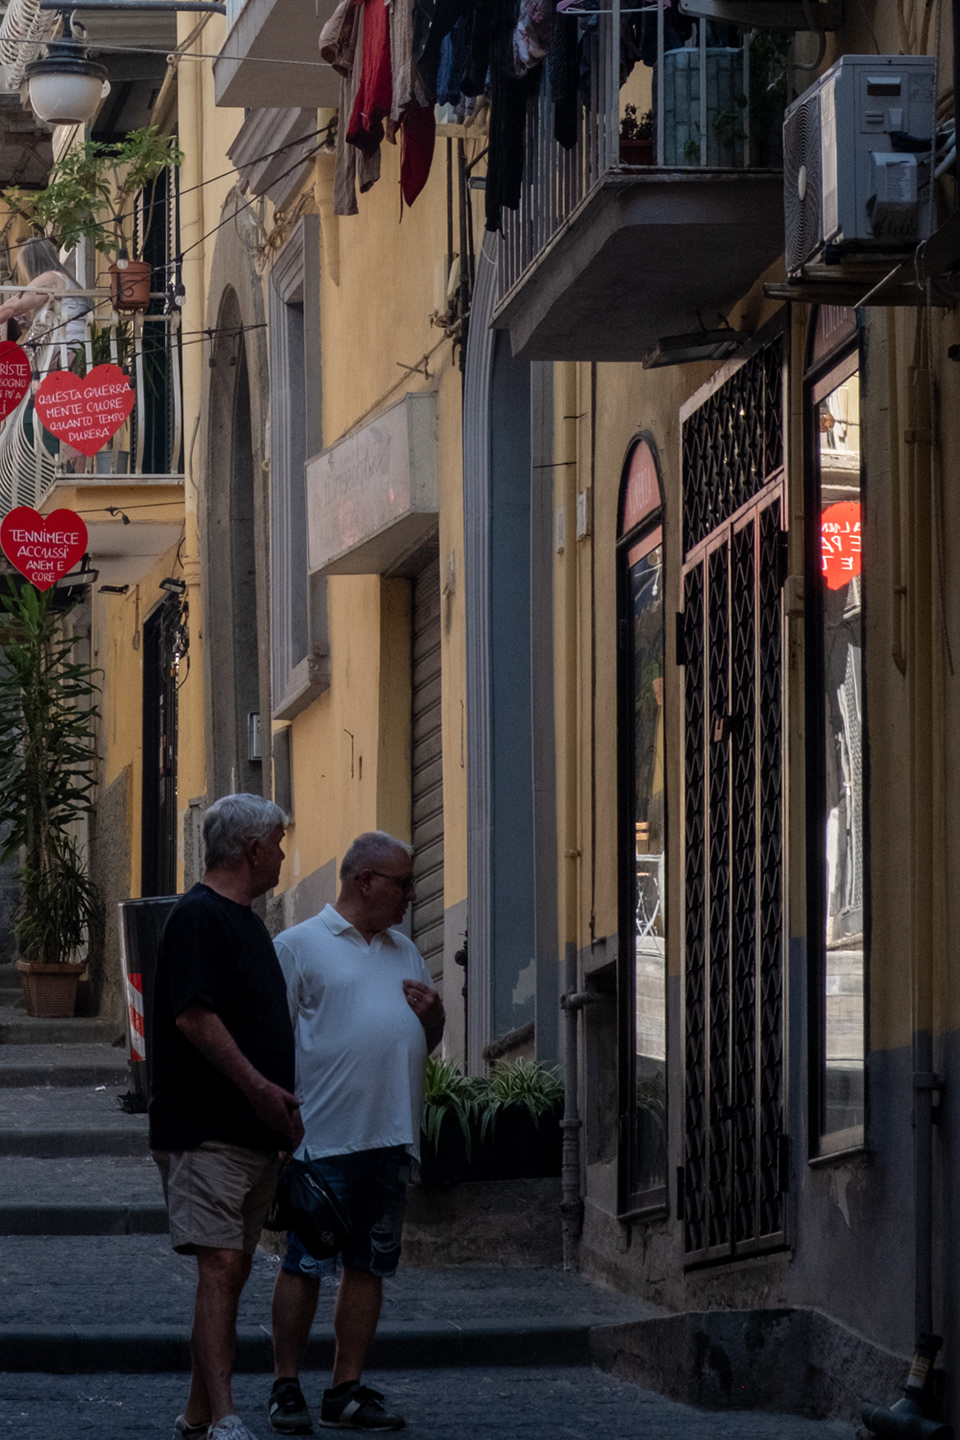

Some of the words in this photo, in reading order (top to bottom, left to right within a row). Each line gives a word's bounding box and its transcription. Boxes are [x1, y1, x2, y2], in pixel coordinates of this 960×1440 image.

[38, 389, 82, 405] QUESTA
[83, 382, 131, 398] GUERRA
[46, 403, 84, 418] MENTE
[86, 397, 123, 412] CUORE
[50, 416, 92, 430] QUANTO
[95, 412, 125, 424] TEMPO
[8, 528, 79, 545] TENNIMECE
[26, 560, 54, 570] ANEM
[57, 561, 64, 571] E
[32, 572, 55, 582] CORE
